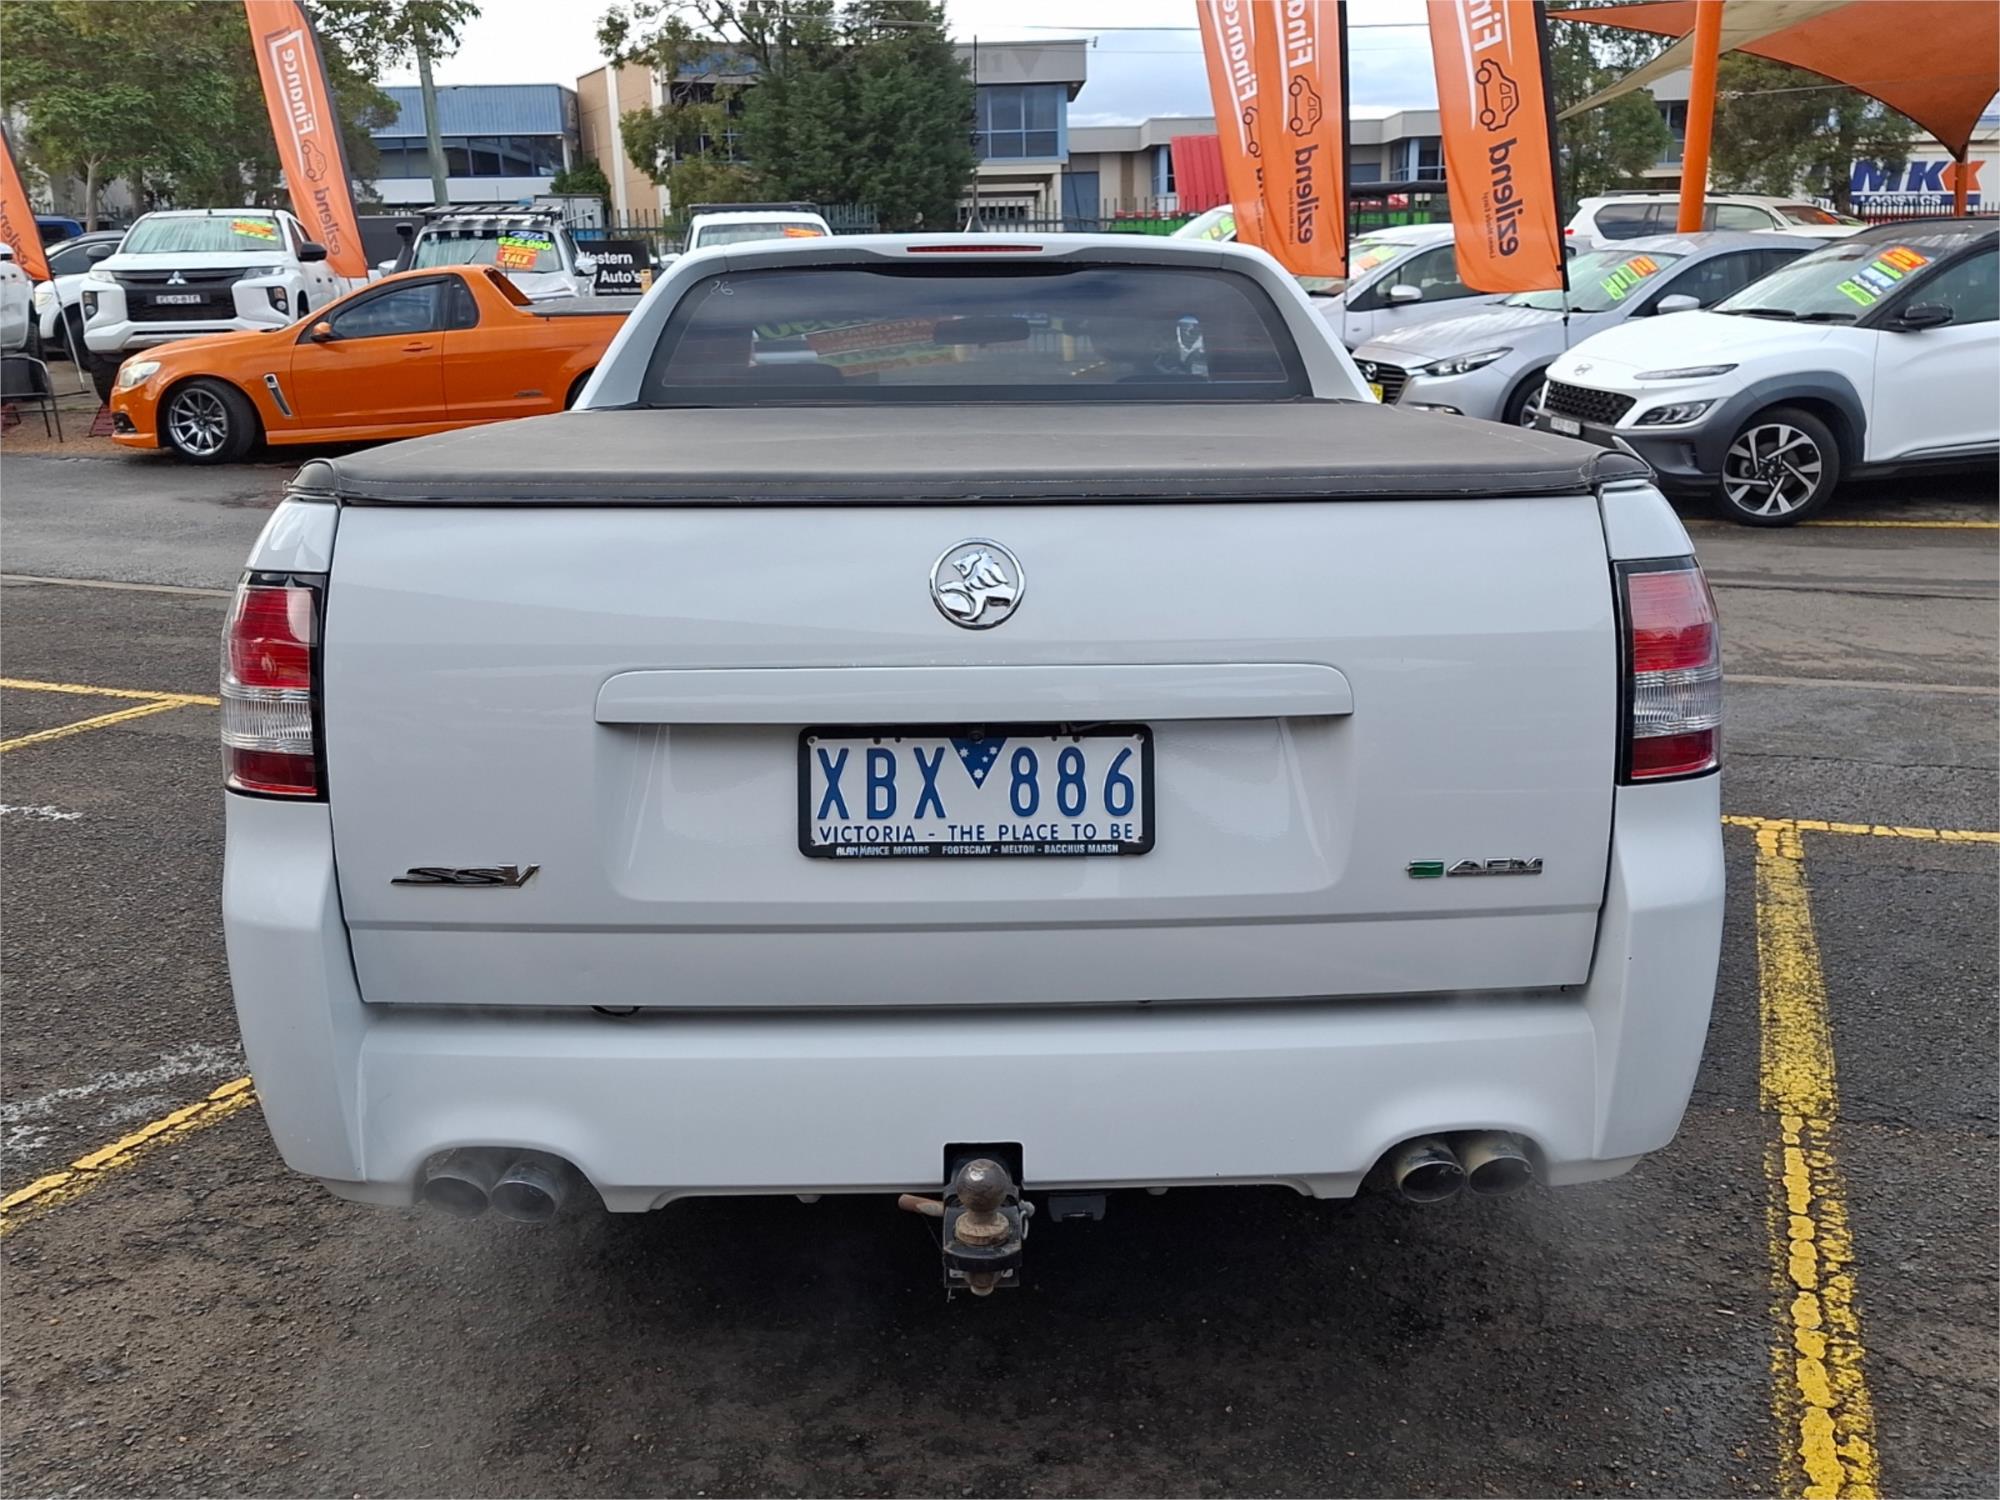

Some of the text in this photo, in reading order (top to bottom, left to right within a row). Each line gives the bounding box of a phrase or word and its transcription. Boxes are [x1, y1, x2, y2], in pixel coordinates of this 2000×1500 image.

[600, 270, 642, 283] Auto's
[817, 747, 1135, 820] XBX 886
[819, 825, 916, 842] VICTORIA
[948, 825, 986, 841] THE
[998, 824, 1059, 841] PLACE
[1071, 824, 1097, 840] TO
[1111, 823, 1134, 840] BE
[893, 846, 930, 855] MOTORS
[942, 845, 992, 854] FOOTSCRAY
[1001, 844, 1035, 854] MELTON
[1044, 844, 1085, 854] BACCHUS
[1087, 844, 1119, 853] MARSH
